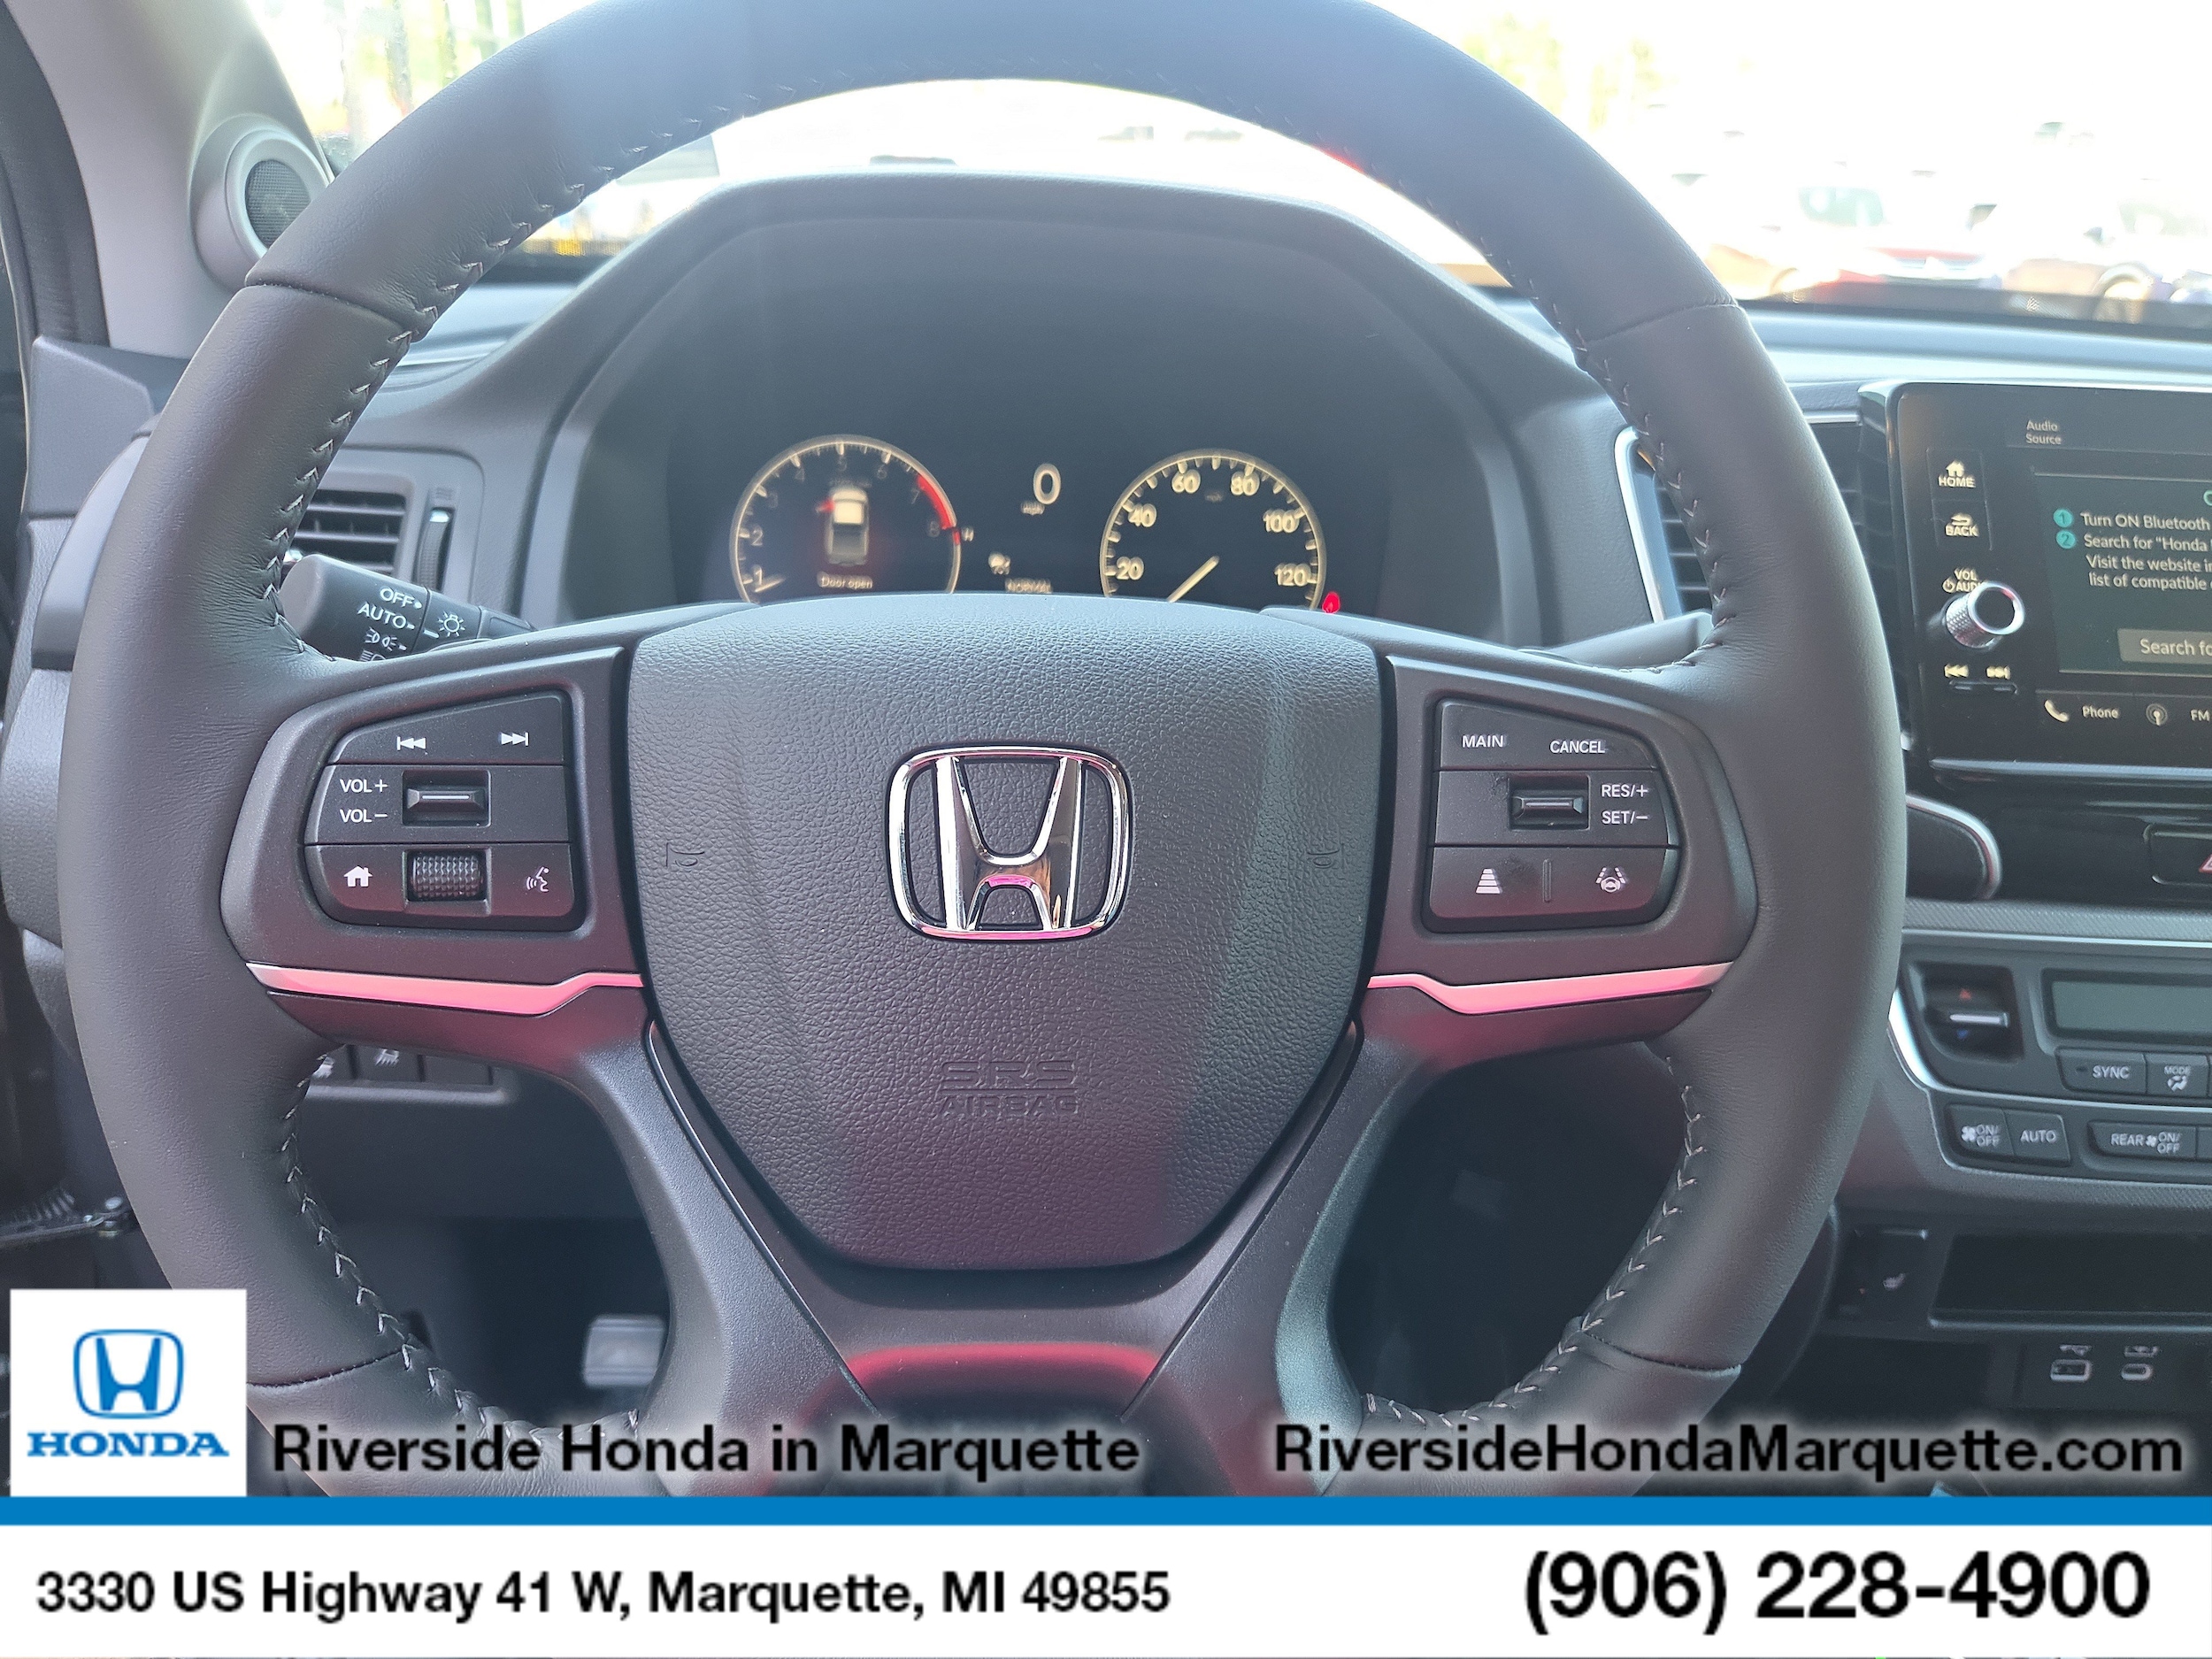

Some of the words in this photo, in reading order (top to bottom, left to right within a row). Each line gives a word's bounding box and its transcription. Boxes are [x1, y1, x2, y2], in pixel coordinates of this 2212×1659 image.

[2026, 419, 2058, 432] Audio
[2025, 433, 2062, 445] Source
[1033, 463, 1062, 504] 0
[1171, 467, 1201, 494] 60
[1230, 469, 1260, 495] 80
[1938, 476, 1977, 488] HOME
[1128, 503, 1157, 527] 40
[1263, 508, 1300, 533] 100
[2081, 511, 2111, 527] Turn
[2115, 513, 2139, 528] ON
[2143, 515, 2210, 531] Bluetooth
[1945, 525, 1978, 537] BACK
[2084, 533, 2129, 549] Search
[2132, 534, 2153, 550] for
[1117, 557, 1144, 580] 20
[2086, 555, 2117, 569] Visit
[2121, 556, 2144, 571] the
[2147, 557, 2201, 572] website
[818, 573, 845, 589] Door
[847, 575, 873, 590] open
[1274, 563, 1311, 588] 120
[1954, 567, 1978, 581] VOL
[1955, 580, 1981, 593] AUD
[2088, 573, 2109, 588] list
[2113, 574, 2128, 588] of
[2131, 575, 2207, 591] compatible
[380, 588, 415, 608] OFF
[357, 602, 407, 630] AUTO
[2139, 639, 2195, 656] Search
[2082, 706, 2118, 719] Phone
[2190, 710, 2210, 722] FM
[1462, 735, 1505, 748] MAIN
[1549, 740, 1606, 754] CANCEL
[1601, 784, 1648, 798] RES/+
[941, 1061, 1075, 1088] SRS
[2093, 1065, 2130, 1079] SYNC
[2164, 1066, 2191, 1076] MODE
[940, 1094, 1079, 1118] AIRBAG
[1976, 1136, 2000, 1147] OFF
[2021, 1130, 2057, 1143] AUTO
[2110, 1133, 2145, 1147] REAR
[2157, 1144, 2180, 1154] OFF
